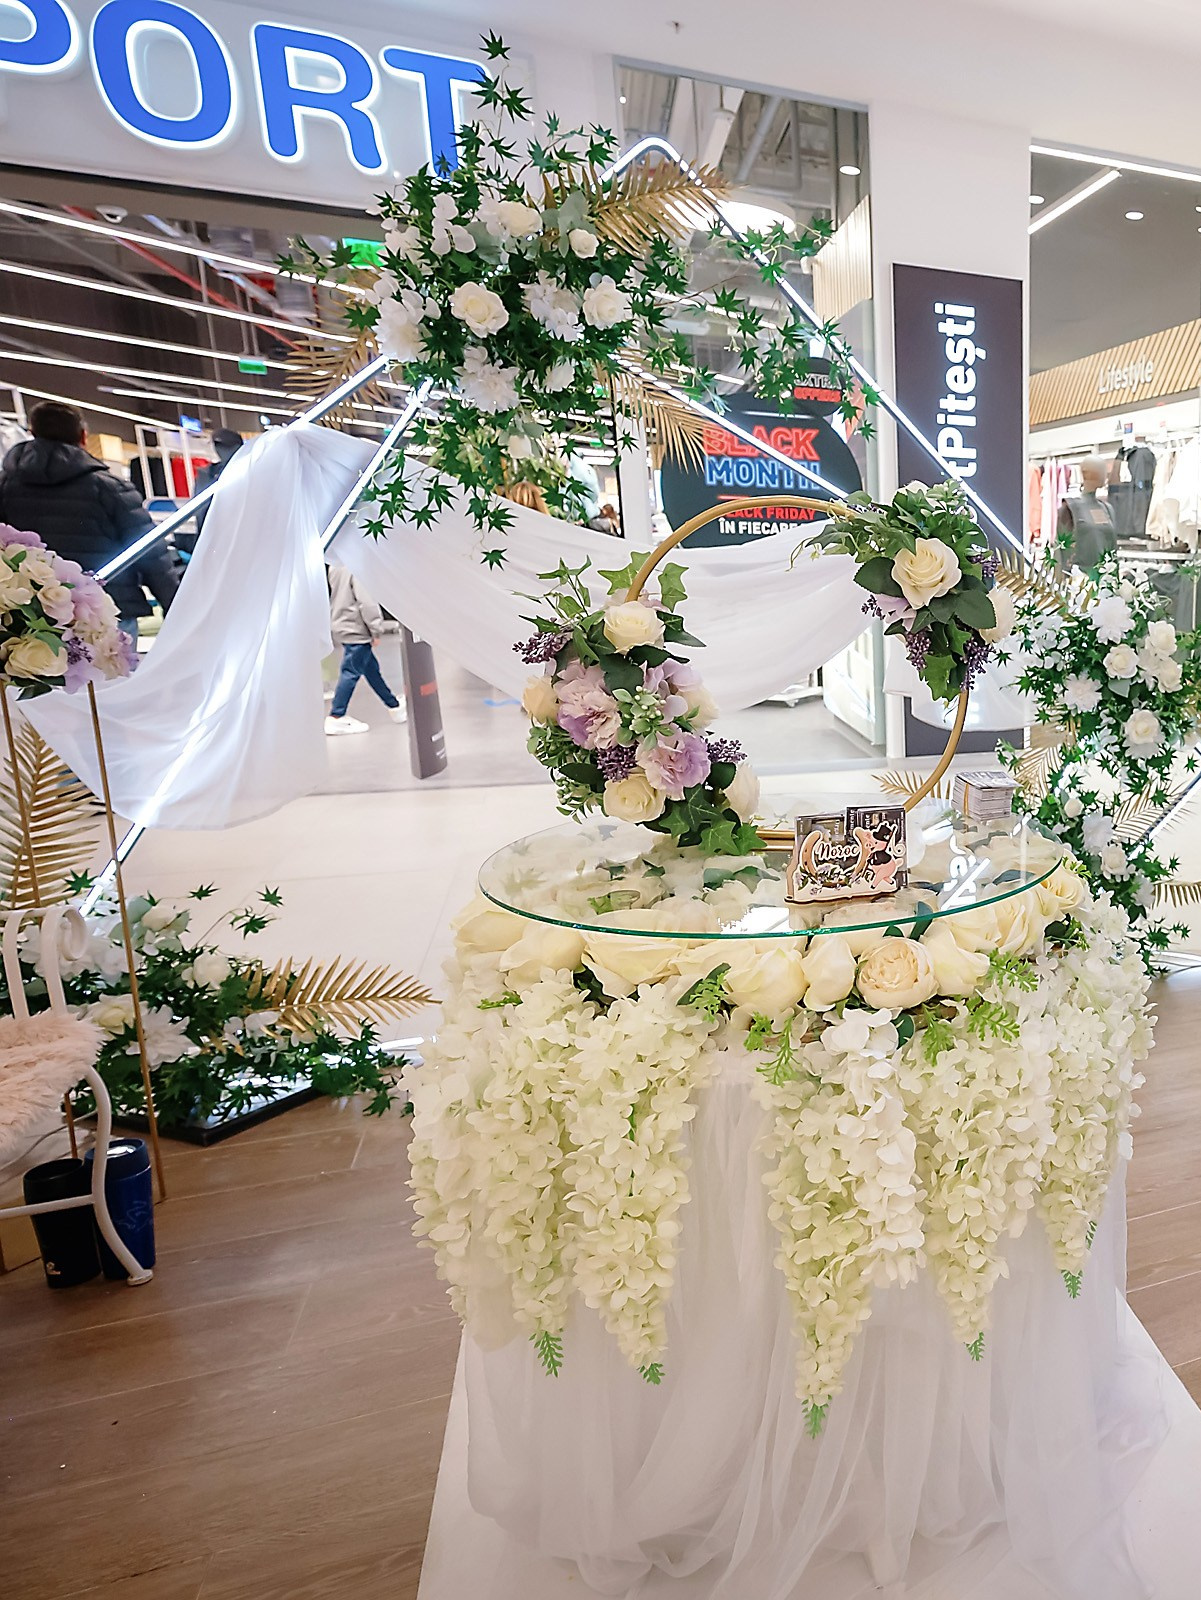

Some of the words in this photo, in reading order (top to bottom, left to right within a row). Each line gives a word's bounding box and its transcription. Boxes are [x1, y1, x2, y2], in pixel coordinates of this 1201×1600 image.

[1098, 353, 1154, 395] Lifestyle
[766, 507, 816, 520] FRIDAY
[816, 841, 859, 860] Noroc
